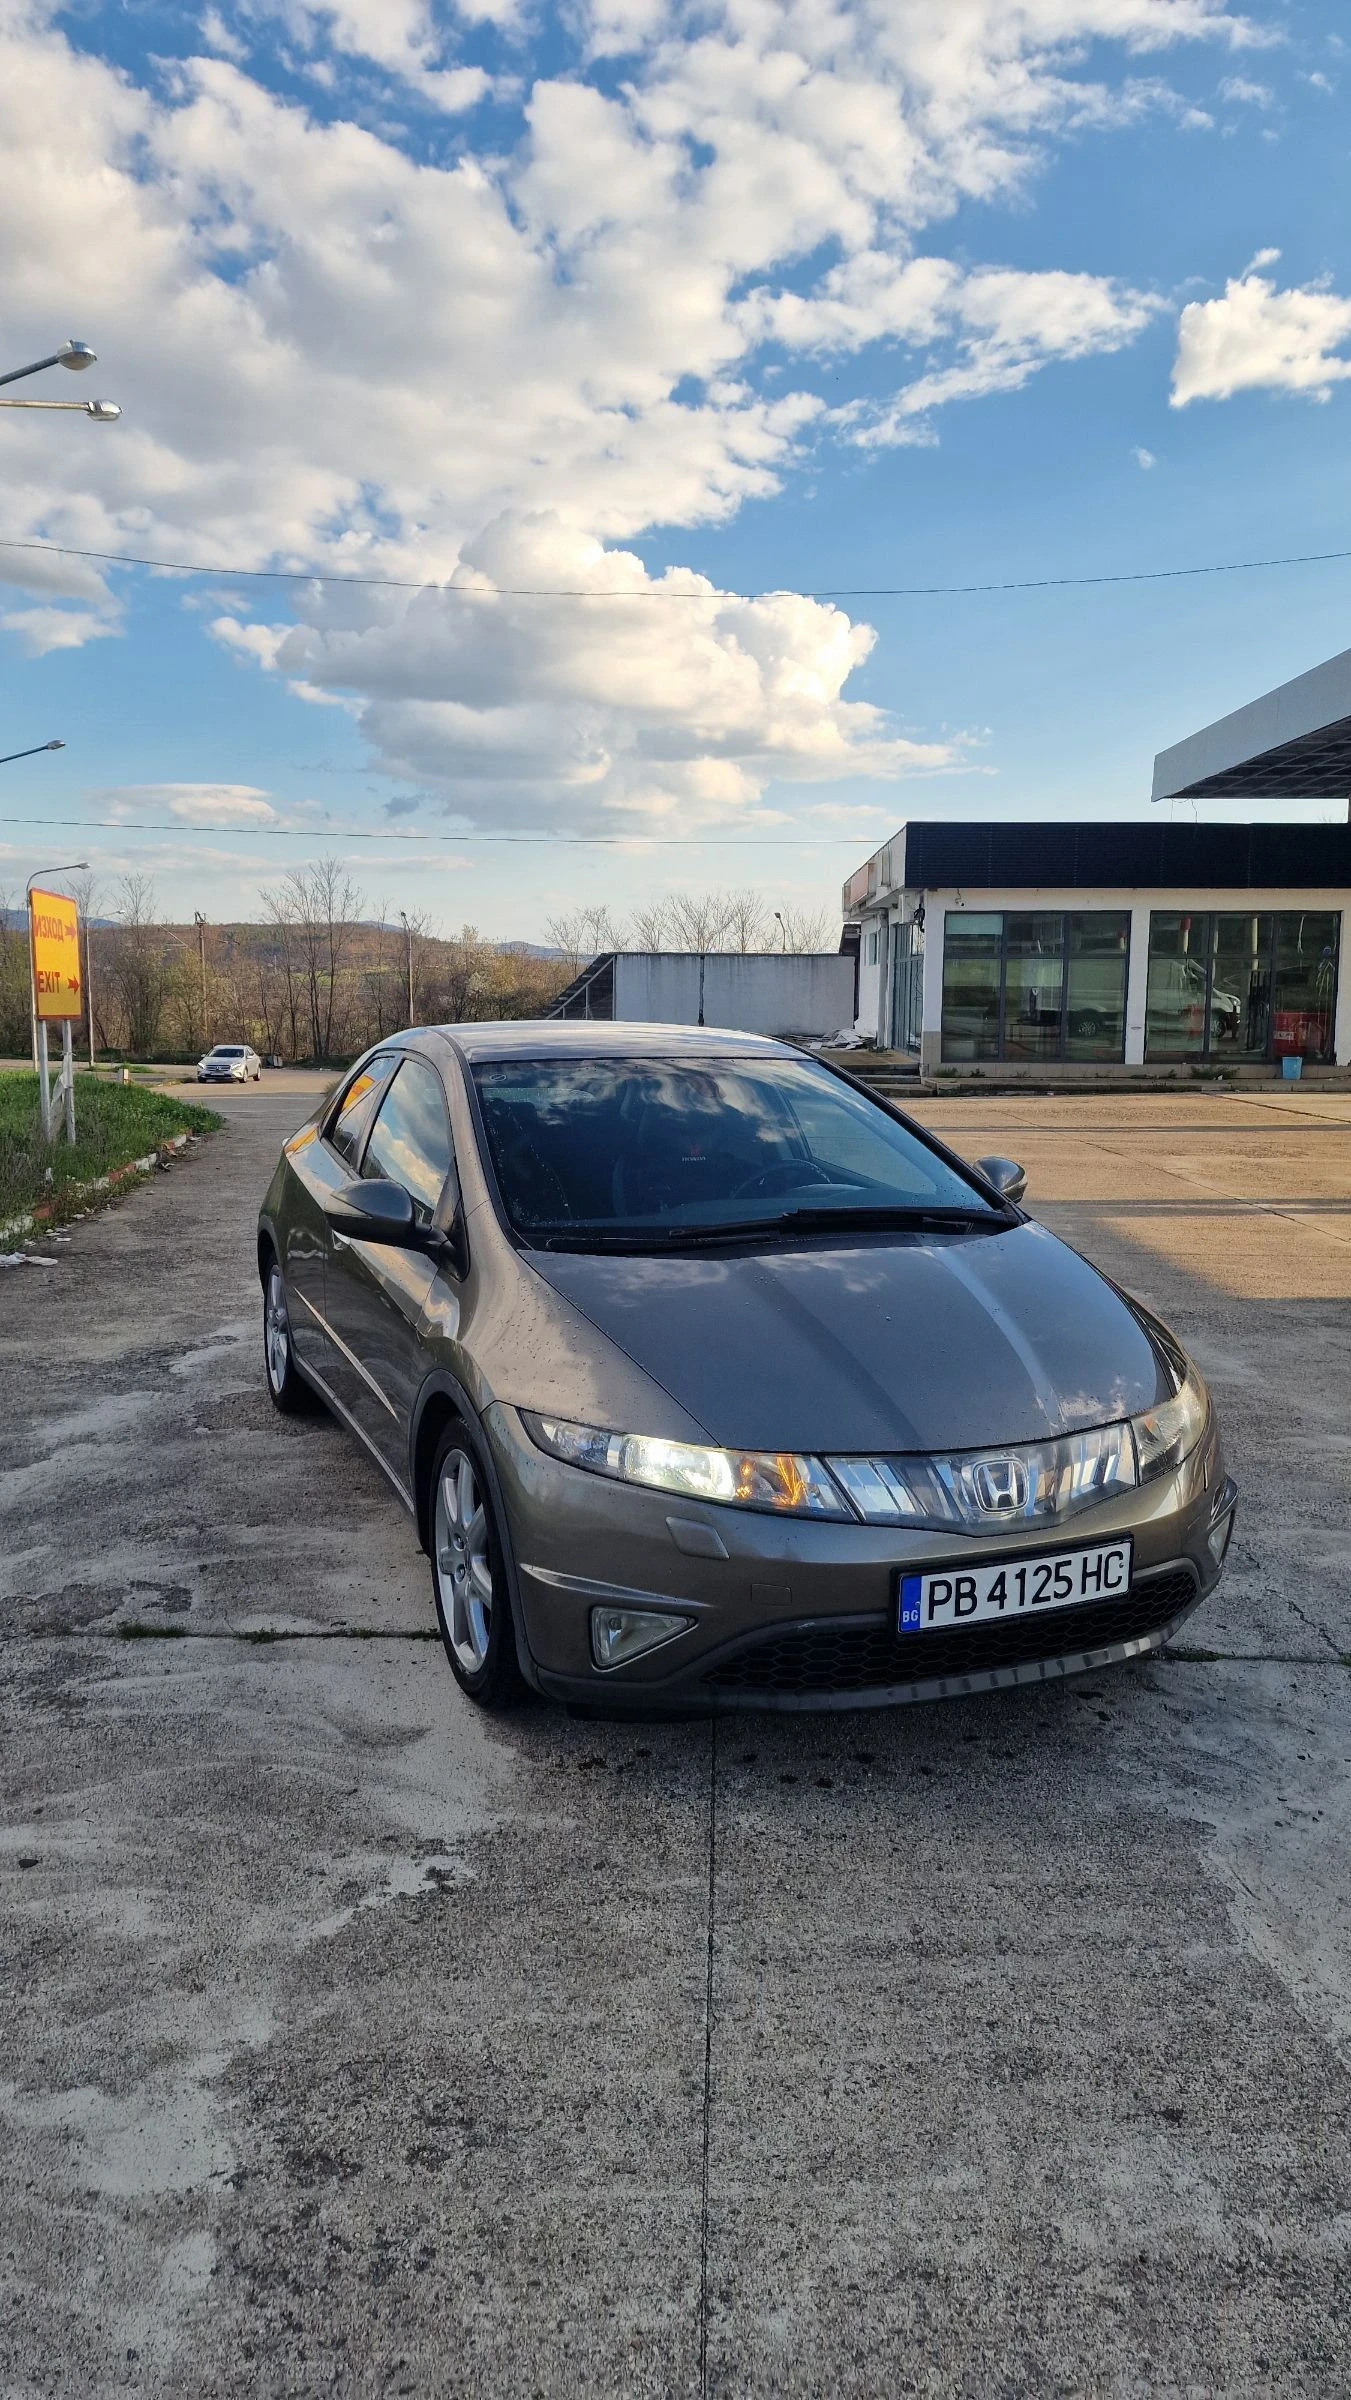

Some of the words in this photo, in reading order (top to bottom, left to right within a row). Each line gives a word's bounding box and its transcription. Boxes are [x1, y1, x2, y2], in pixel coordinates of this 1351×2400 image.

[33, 915, 64, 942] ИЗХОД
[37, 971, 60, 993] EXIT
[928, 1576, 977, 1621] PB
[987, 1560, 1073, 1610] 4125
[1081, 1551, 1123, 1595] HC
[902, 1609, 919, 1623] BG
